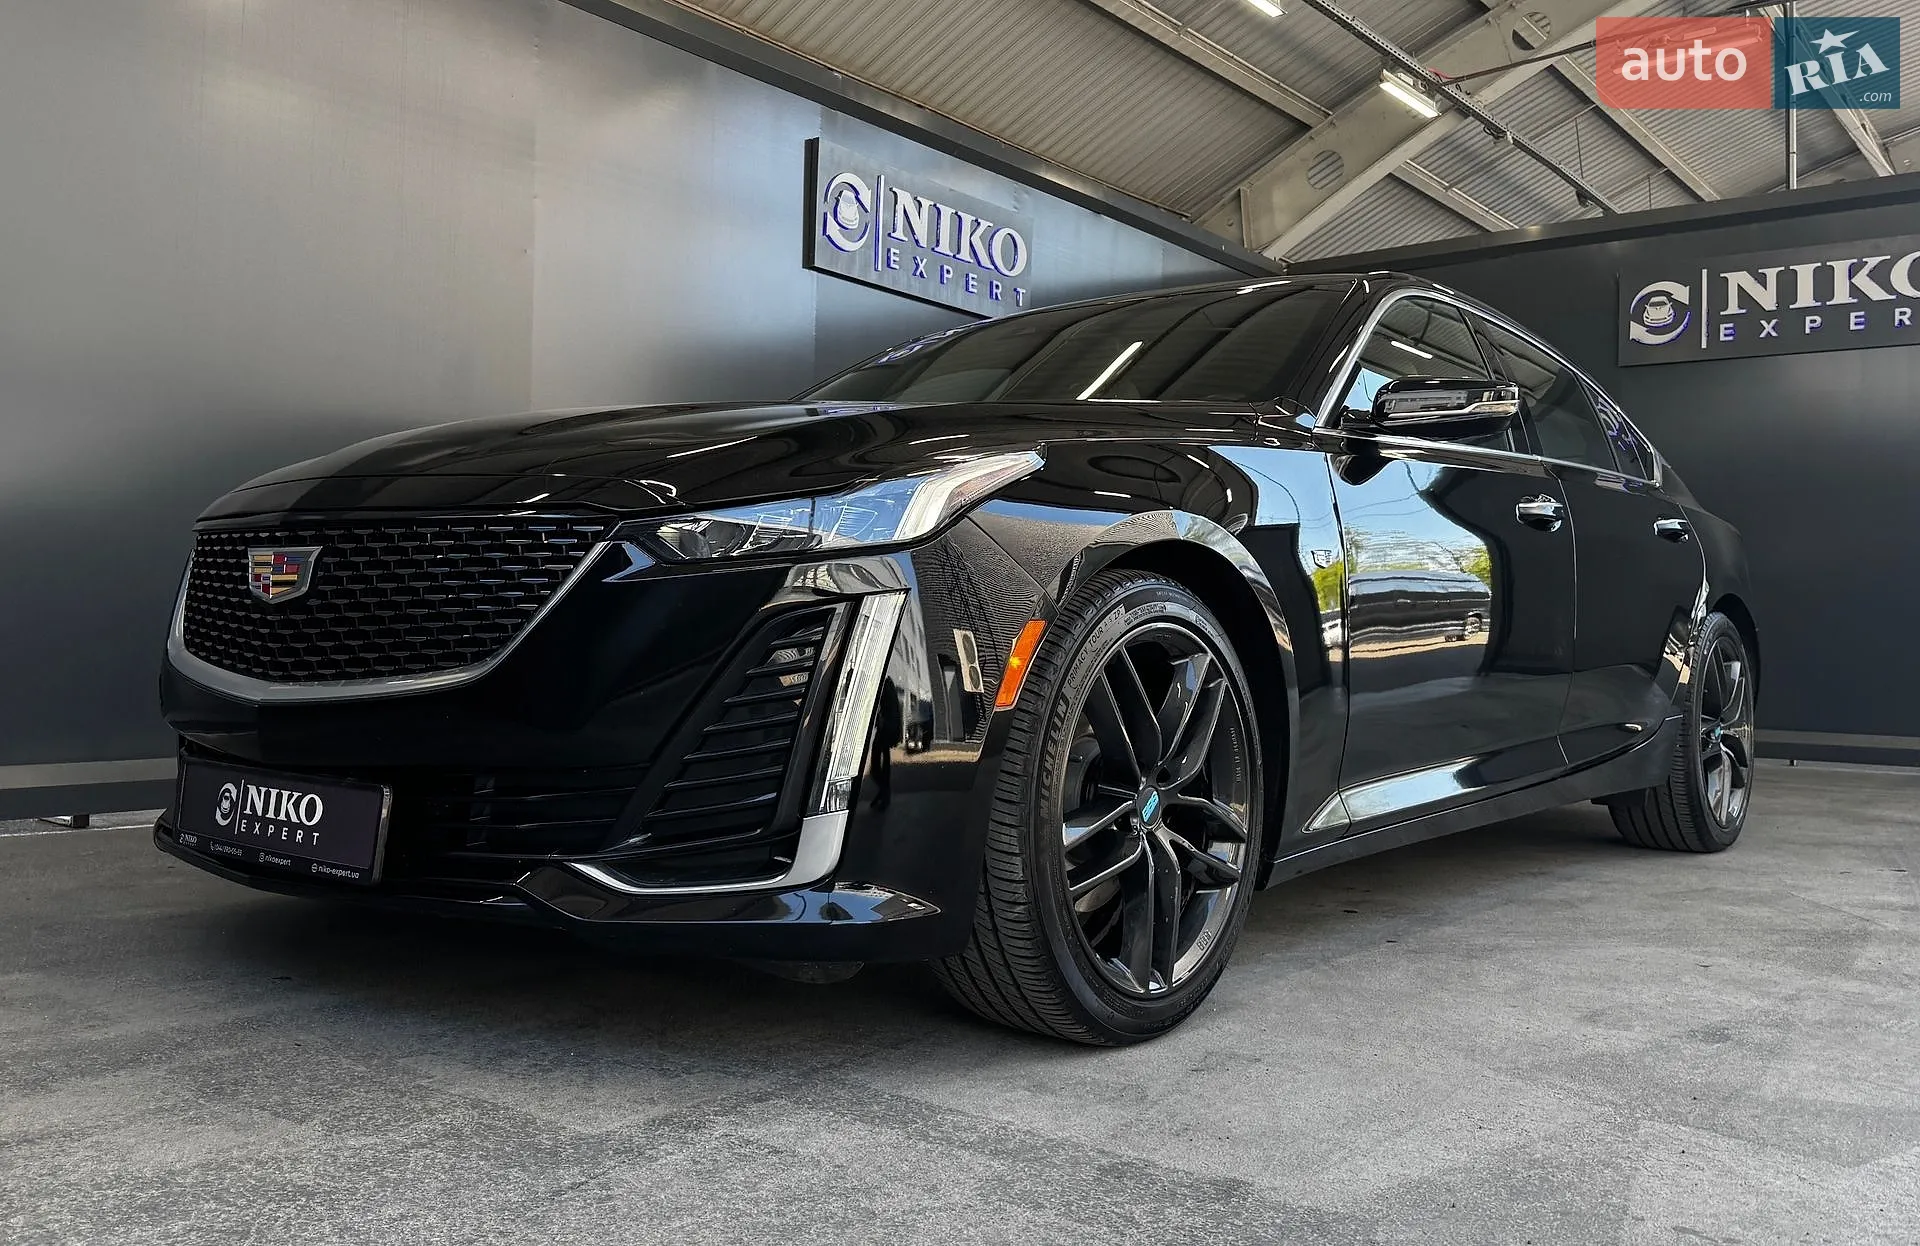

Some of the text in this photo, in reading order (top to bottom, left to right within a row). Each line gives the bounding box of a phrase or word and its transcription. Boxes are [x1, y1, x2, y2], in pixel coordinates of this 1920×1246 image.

[888, 186, 1028, 277] NIKO
[886, 247, 1027, 307] EXPERT
[1067, 646, 1089, 685] PRIMACY
[1088, 626, 1104, 648] TOUR
[1039, 691, 1070, 819] MICHELIN
[240, 819, 320, 846] EXPERT
[244, 784, 324, 826] NIKO
